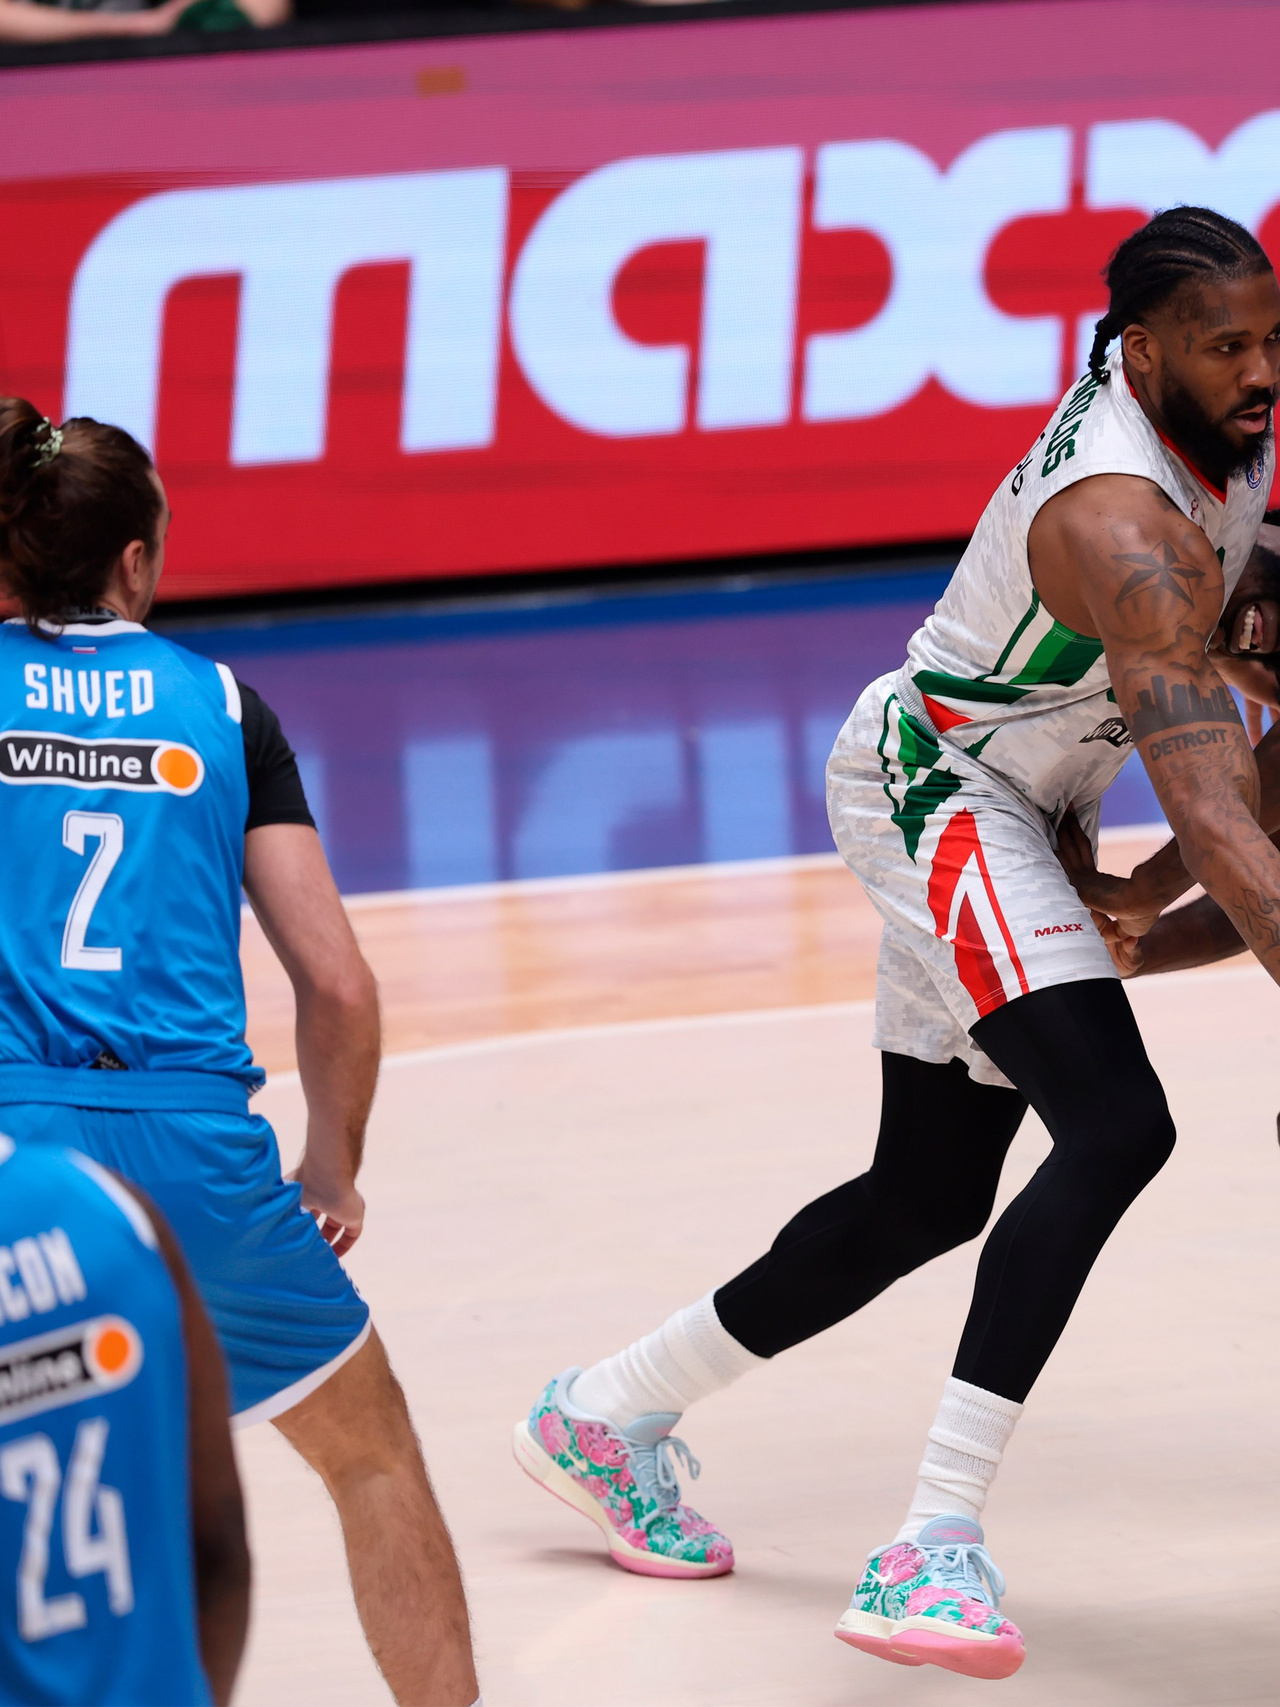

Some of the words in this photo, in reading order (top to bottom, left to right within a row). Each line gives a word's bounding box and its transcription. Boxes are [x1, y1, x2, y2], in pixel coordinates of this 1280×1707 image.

[1041, 362, 1106, 478] NOLDS
[24, 662, 155, 719] SHVED
[7, 742, 142, 779] Winline
[1149, 728, 1228, 762] DETROIT
[61, 810, 124, 971] 2
[1034, 922, 1084, 938] MAXX
[0, 1227, 87, 1326] CON
[1, 1415, 135, 1642] 24
